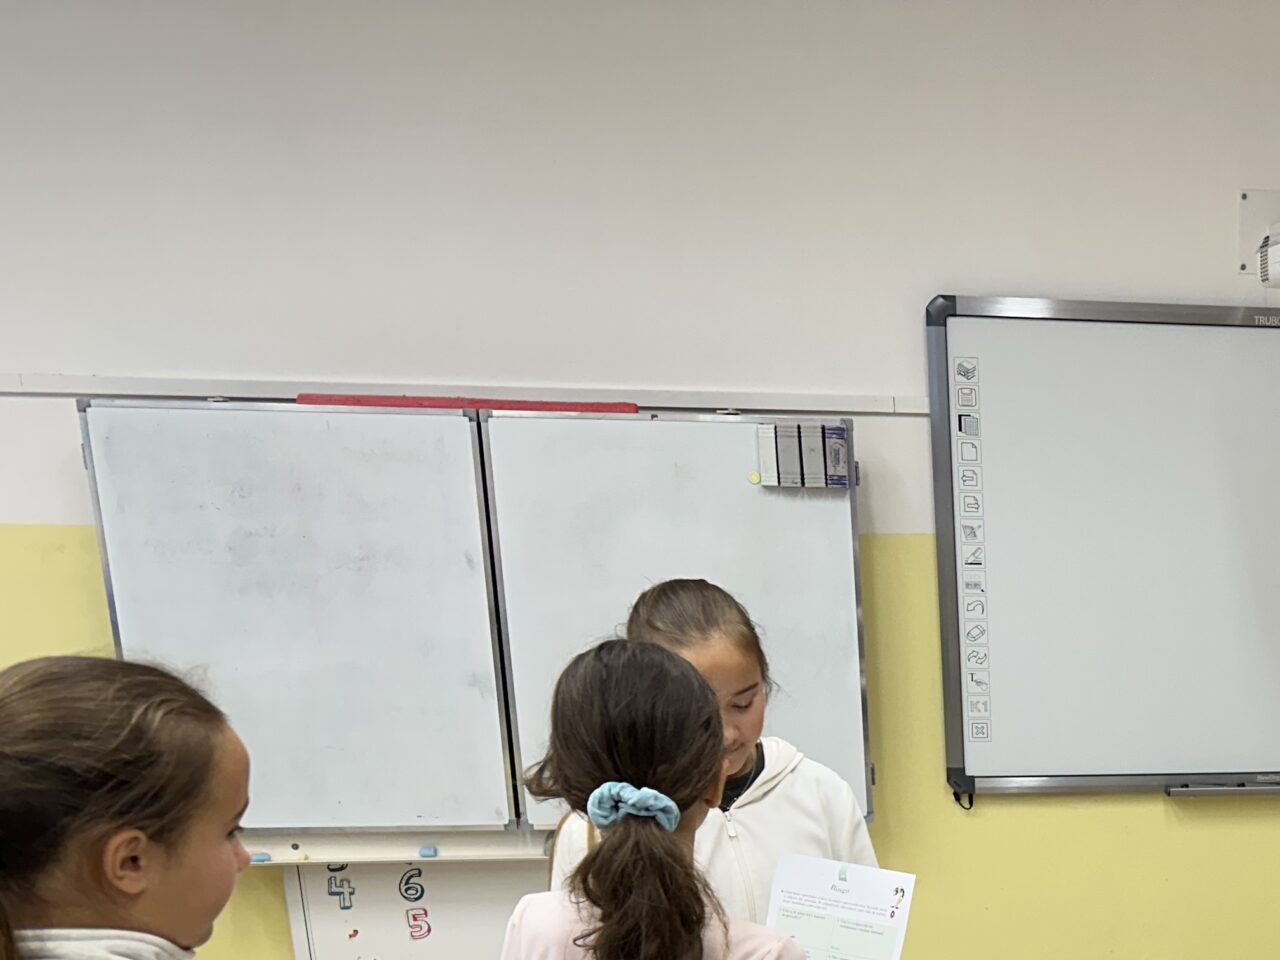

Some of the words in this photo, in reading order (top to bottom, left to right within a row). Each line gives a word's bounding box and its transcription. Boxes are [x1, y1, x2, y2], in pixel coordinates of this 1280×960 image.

[327, 875, 355, 909] 4
[398, 867, 425, 902] 6
[405, 907, 432, 940] 5
